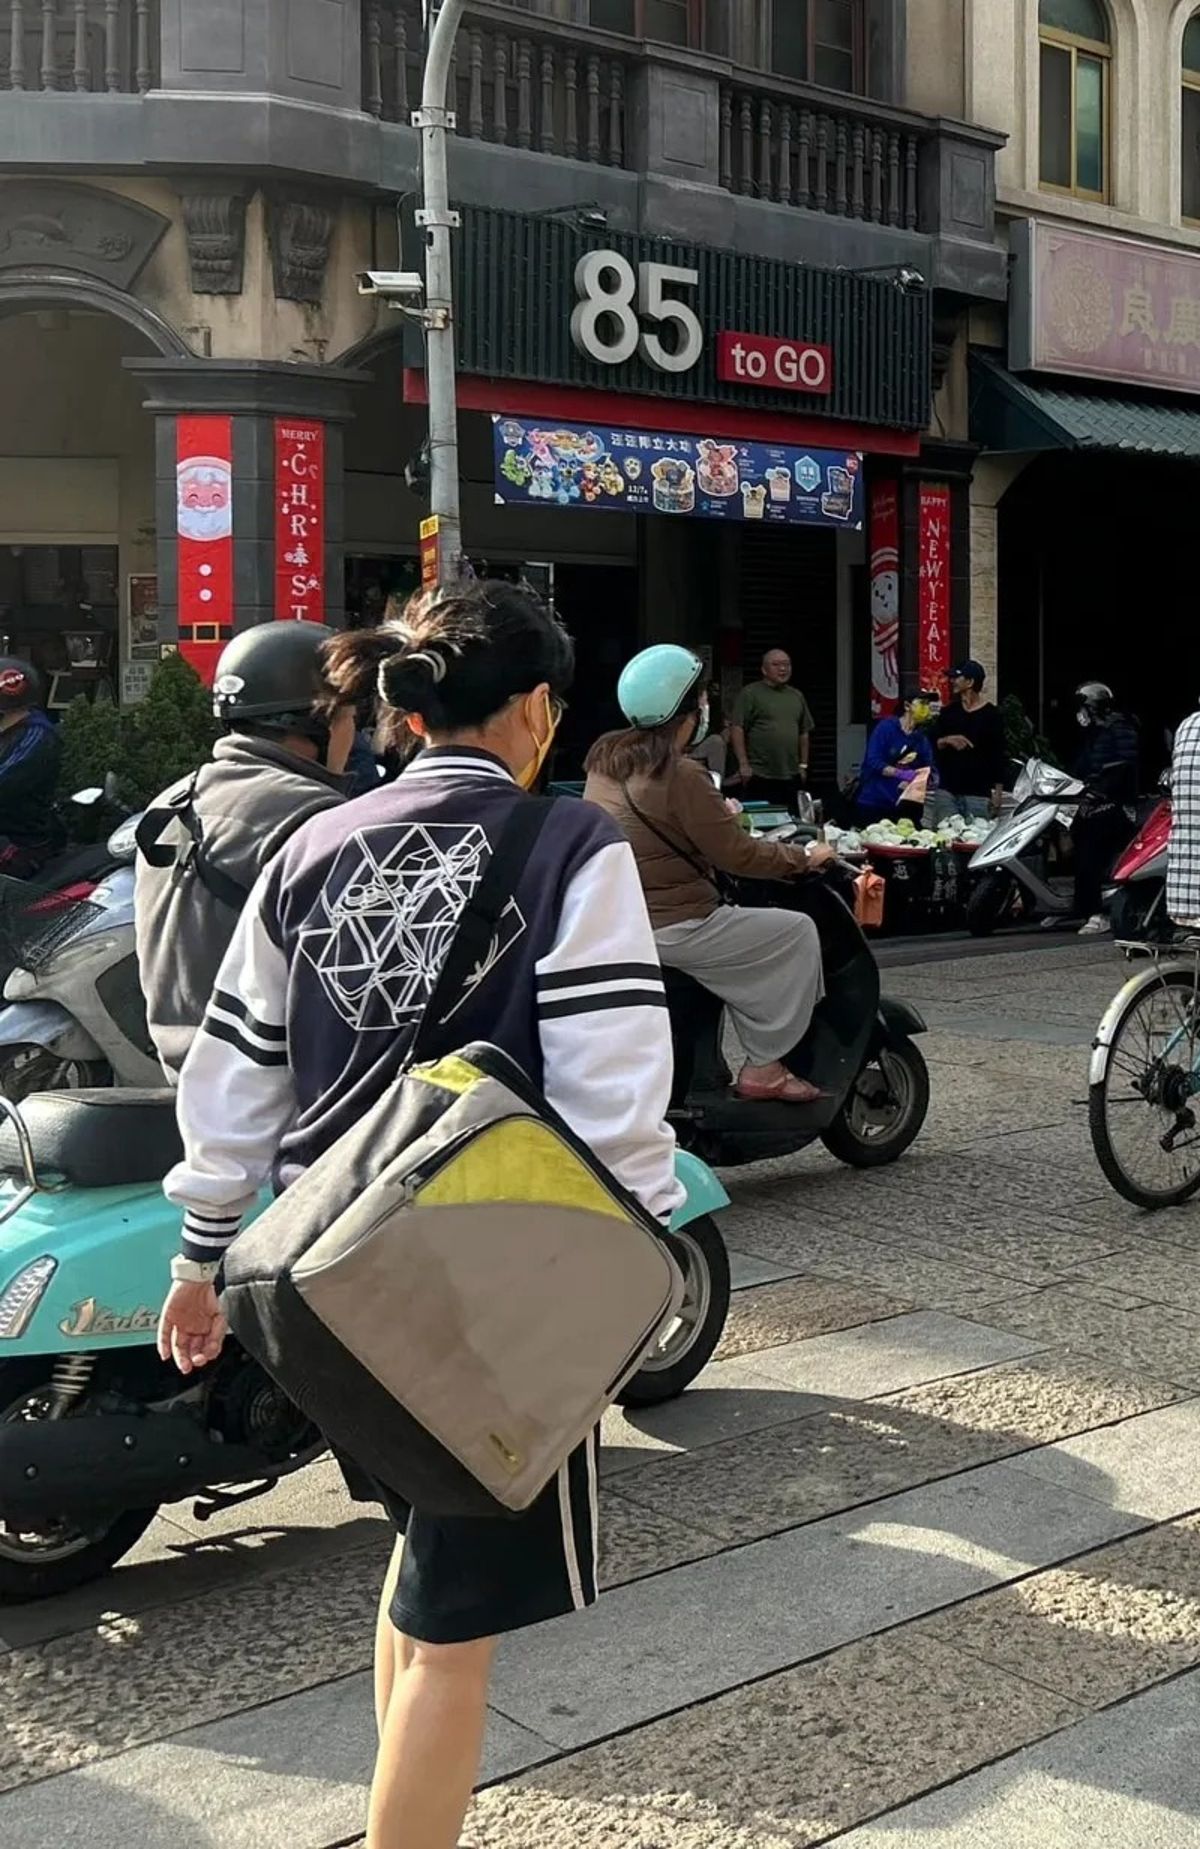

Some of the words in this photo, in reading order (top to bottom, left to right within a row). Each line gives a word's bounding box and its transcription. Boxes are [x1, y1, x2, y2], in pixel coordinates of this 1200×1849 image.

[570, 249, 703, 373] 85
[731, 342, 767, 379] to
[774, 345, 825, 386] GO
[281, 429, 319, 441] MERRY
